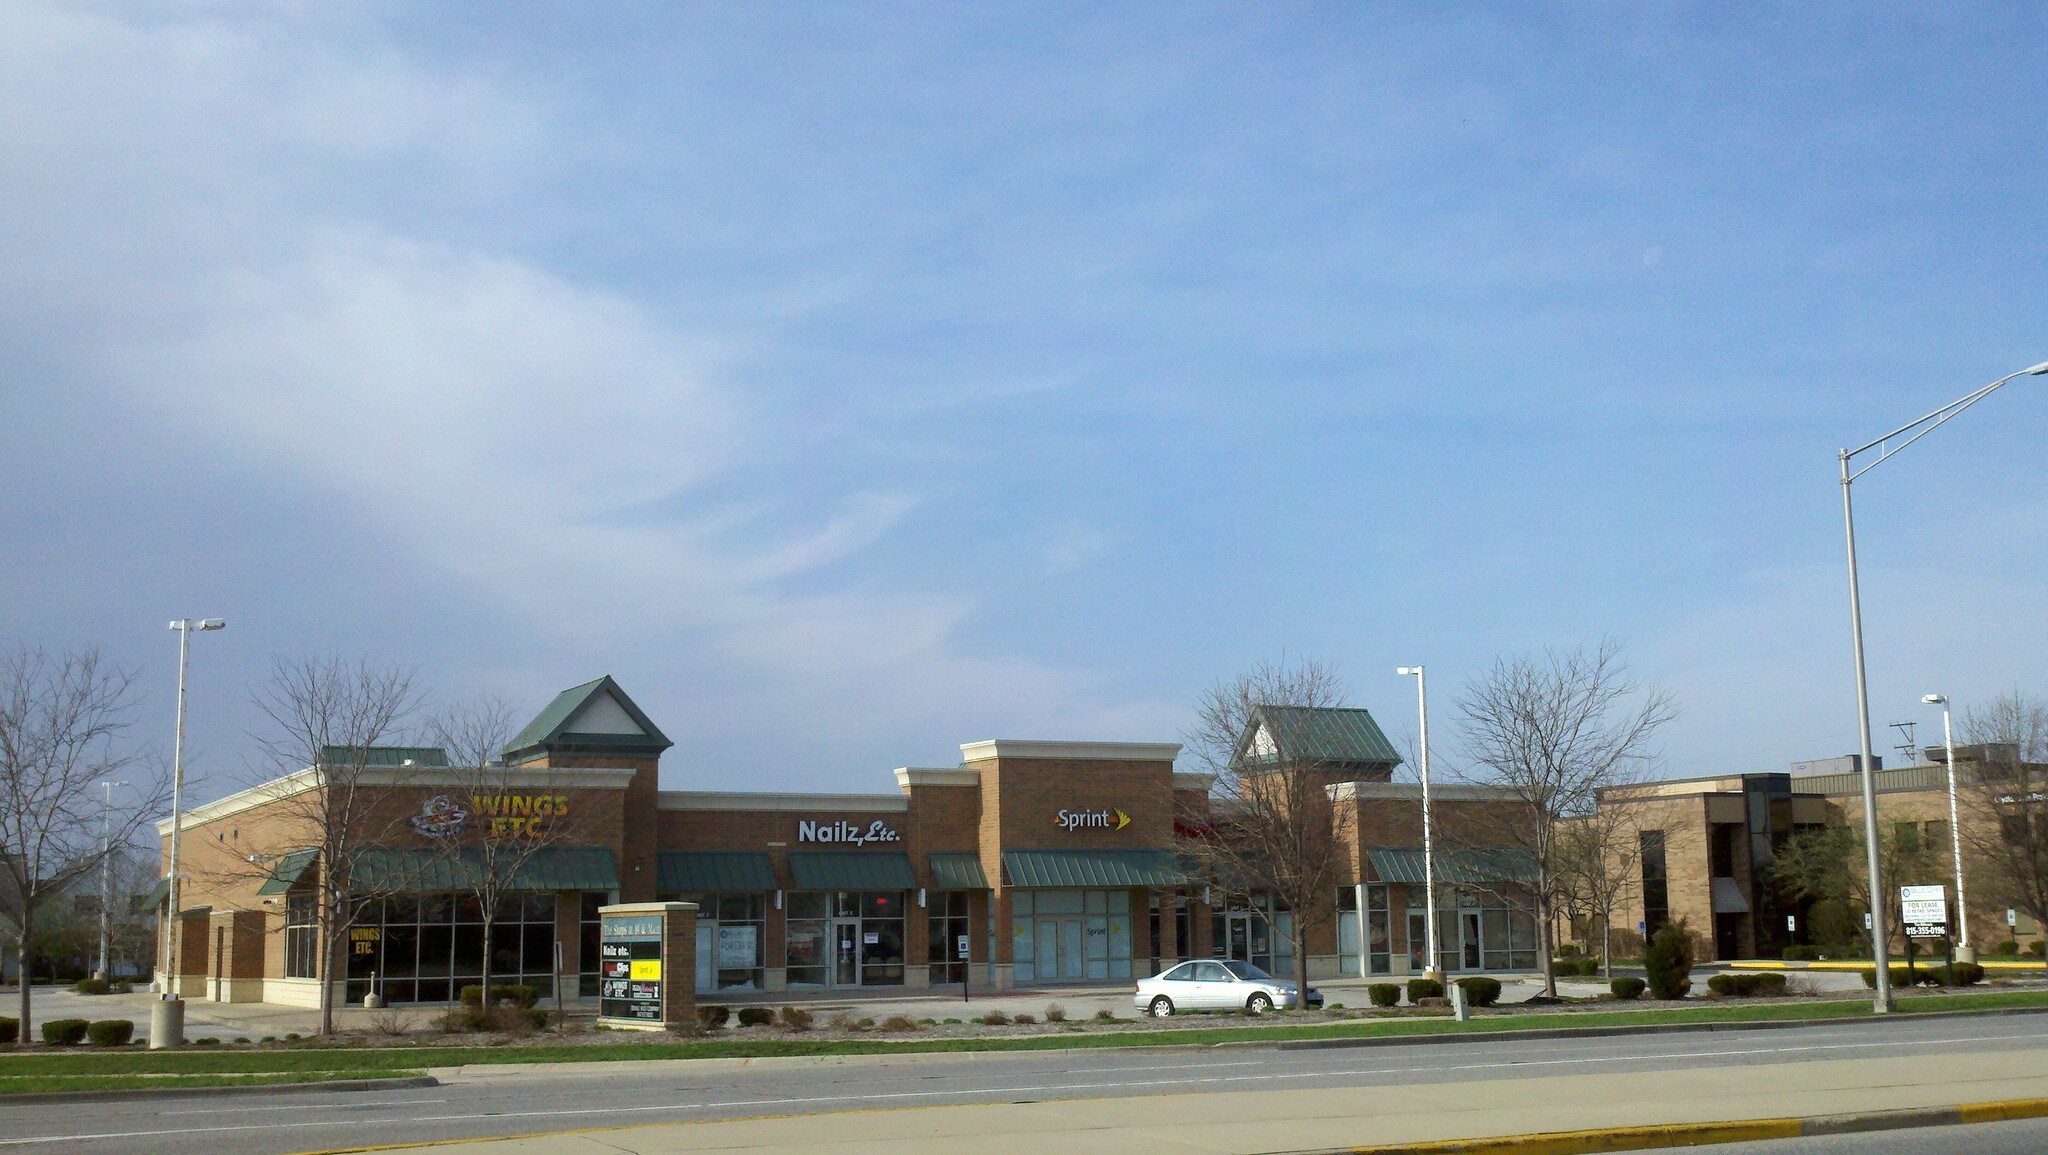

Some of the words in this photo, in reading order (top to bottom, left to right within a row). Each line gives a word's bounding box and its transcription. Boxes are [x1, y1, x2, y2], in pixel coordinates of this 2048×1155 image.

[473, 795, 568, 816] WINGS
[864, 820, 901, 842] Etc.
[1058, 809, 1109, 832] Sprint
[351, 928, 380, 941] WINGS
[1087, 928, 1106, 937] Sprint
